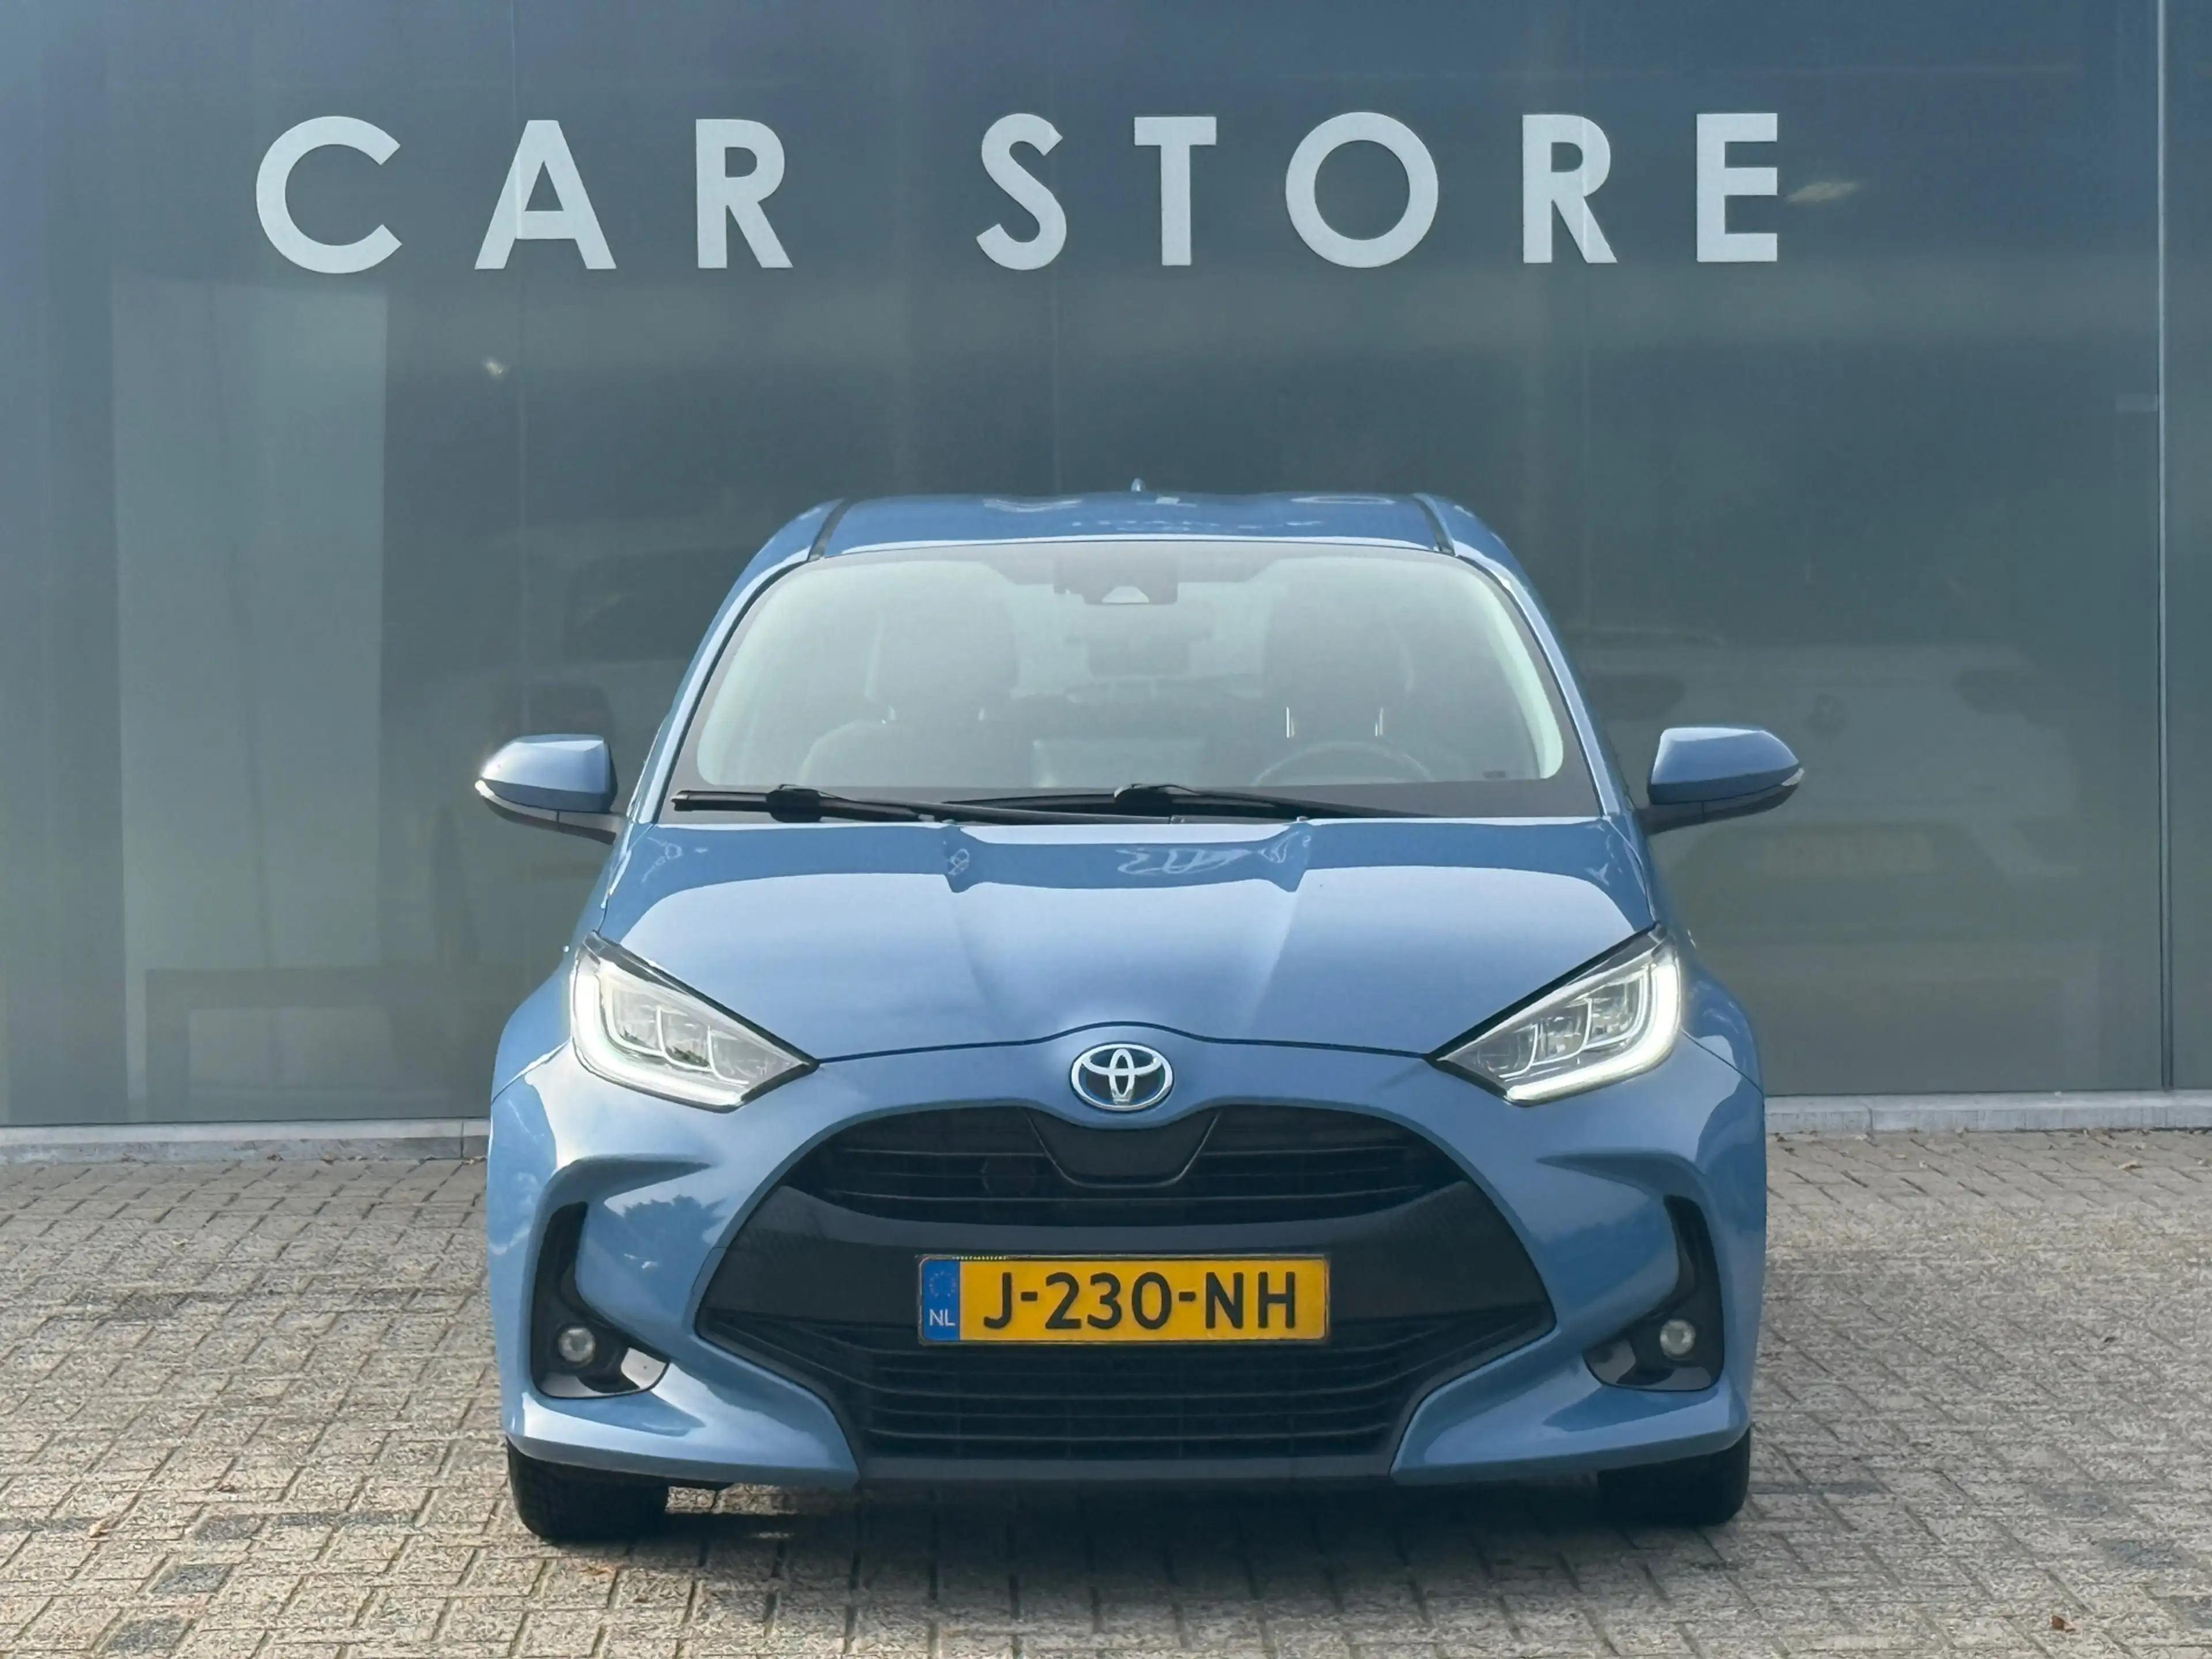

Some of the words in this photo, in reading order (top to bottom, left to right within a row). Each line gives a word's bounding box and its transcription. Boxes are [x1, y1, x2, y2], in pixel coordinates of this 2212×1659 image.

[256, 115, 793, 274] CAR
[976, 111, 1779, 271] STORE
[929, 1309, 956, 1326] NL
[983, 1271, 1297, 1330] J-230-NH
